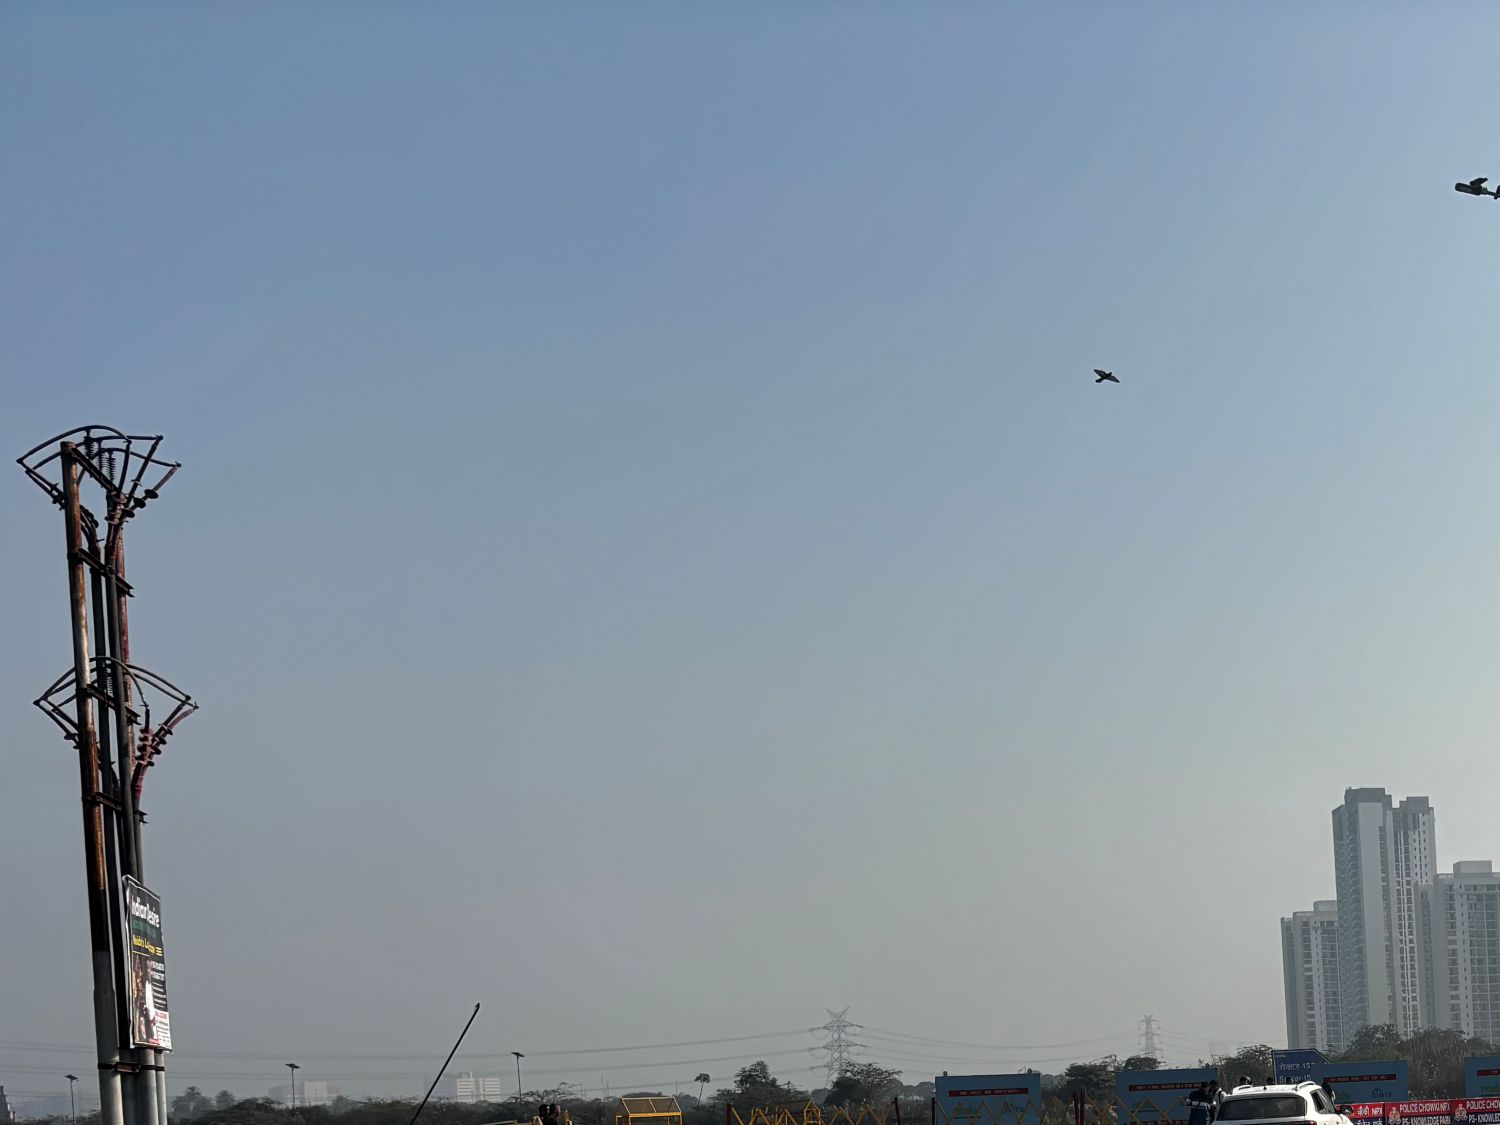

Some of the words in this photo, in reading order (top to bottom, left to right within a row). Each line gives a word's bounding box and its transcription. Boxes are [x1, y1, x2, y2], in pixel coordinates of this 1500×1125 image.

[1399, 1103, 1418, 1113] POLICE
[1418, 1102, 1440, 1112] CHOWKI
[1466, 1100, 1486, 1110] POLICE
[1439, 1115, 1452, 1125] PARK
